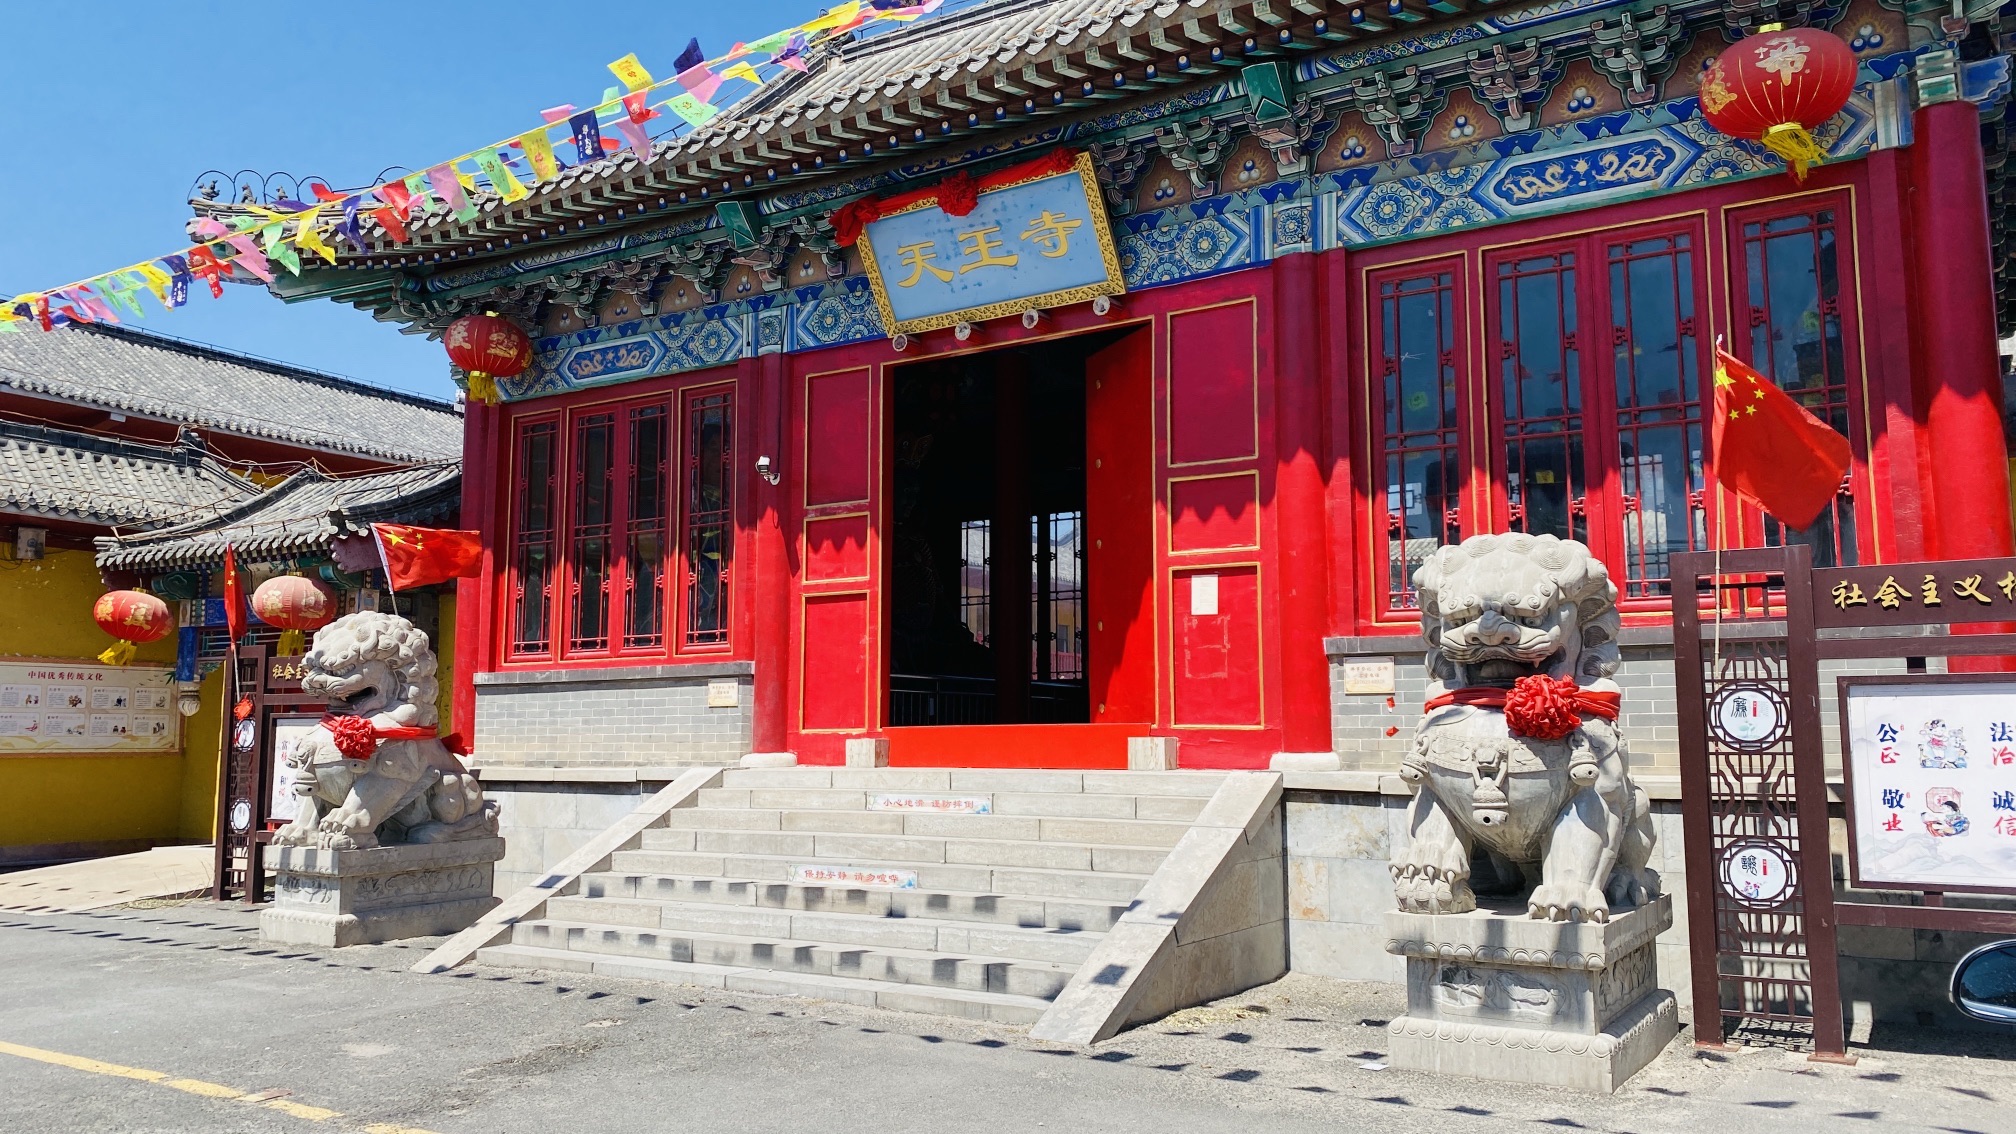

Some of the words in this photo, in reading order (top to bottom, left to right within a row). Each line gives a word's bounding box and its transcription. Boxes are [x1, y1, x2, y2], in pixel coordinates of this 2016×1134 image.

[897, 210, 1082, 288] 天王寺
[28, 670, 103, 682] 中国优秀传统文化
[1876, 723, 1901, 764] 公正
[1990, 722, 2016, 766] 法治
[883, 798, 925, 808] 小心地滑
[1882, 789, 1905, 832] 敬业
[1992, 791, 2016, 836] 诚信
[804, 869, 847, 881] 保持安静
